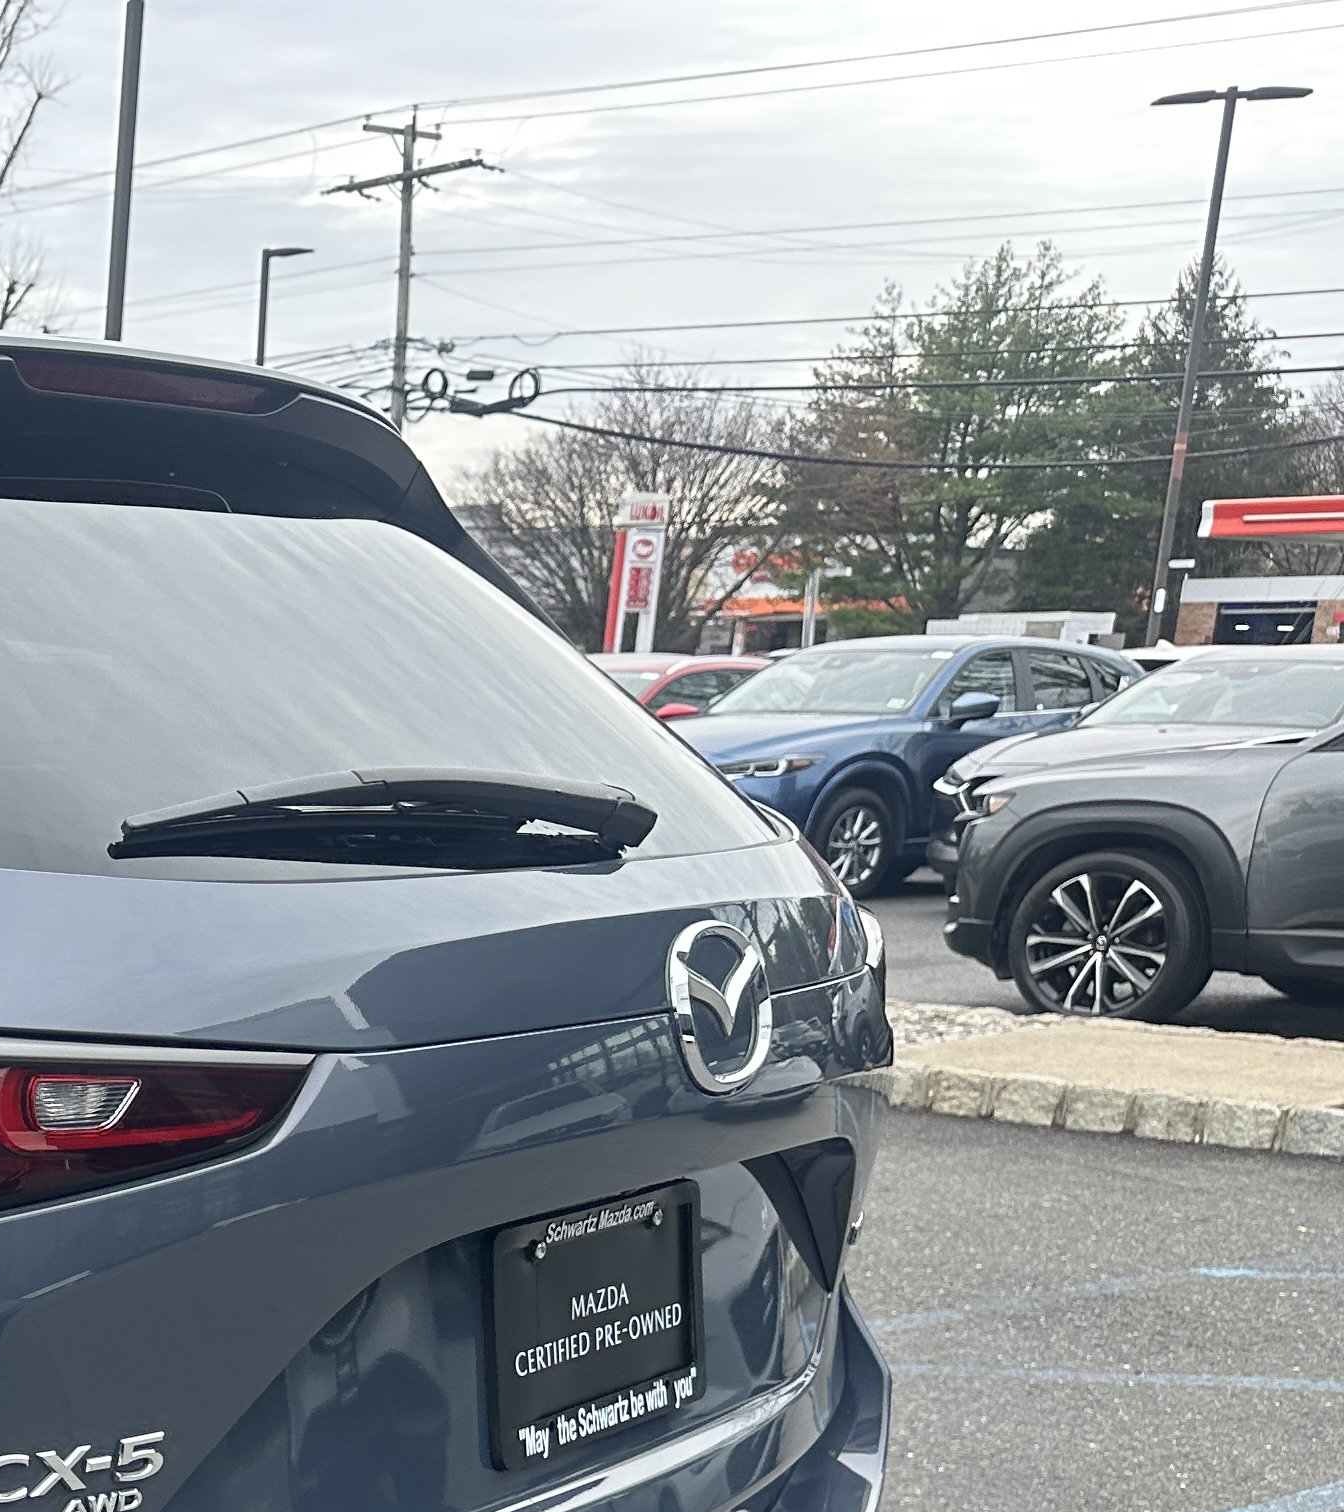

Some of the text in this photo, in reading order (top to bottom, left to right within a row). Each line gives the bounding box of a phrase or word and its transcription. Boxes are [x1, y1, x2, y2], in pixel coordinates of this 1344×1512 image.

[545, 1215, 598, 1244] Schwartz
[571, 1283, 630, 1320] MAZDA
[515, 1303, 682, 1377] CERTIFIED PRE-OWNED
[518, 1425, 550, 1459] "May
[557, 1414, 577, 1445] the
[577, 1395, 630, 1438] Schwartz
[629, 1390, 645, 1418] be
[645, 1379, 668, 1412] with
